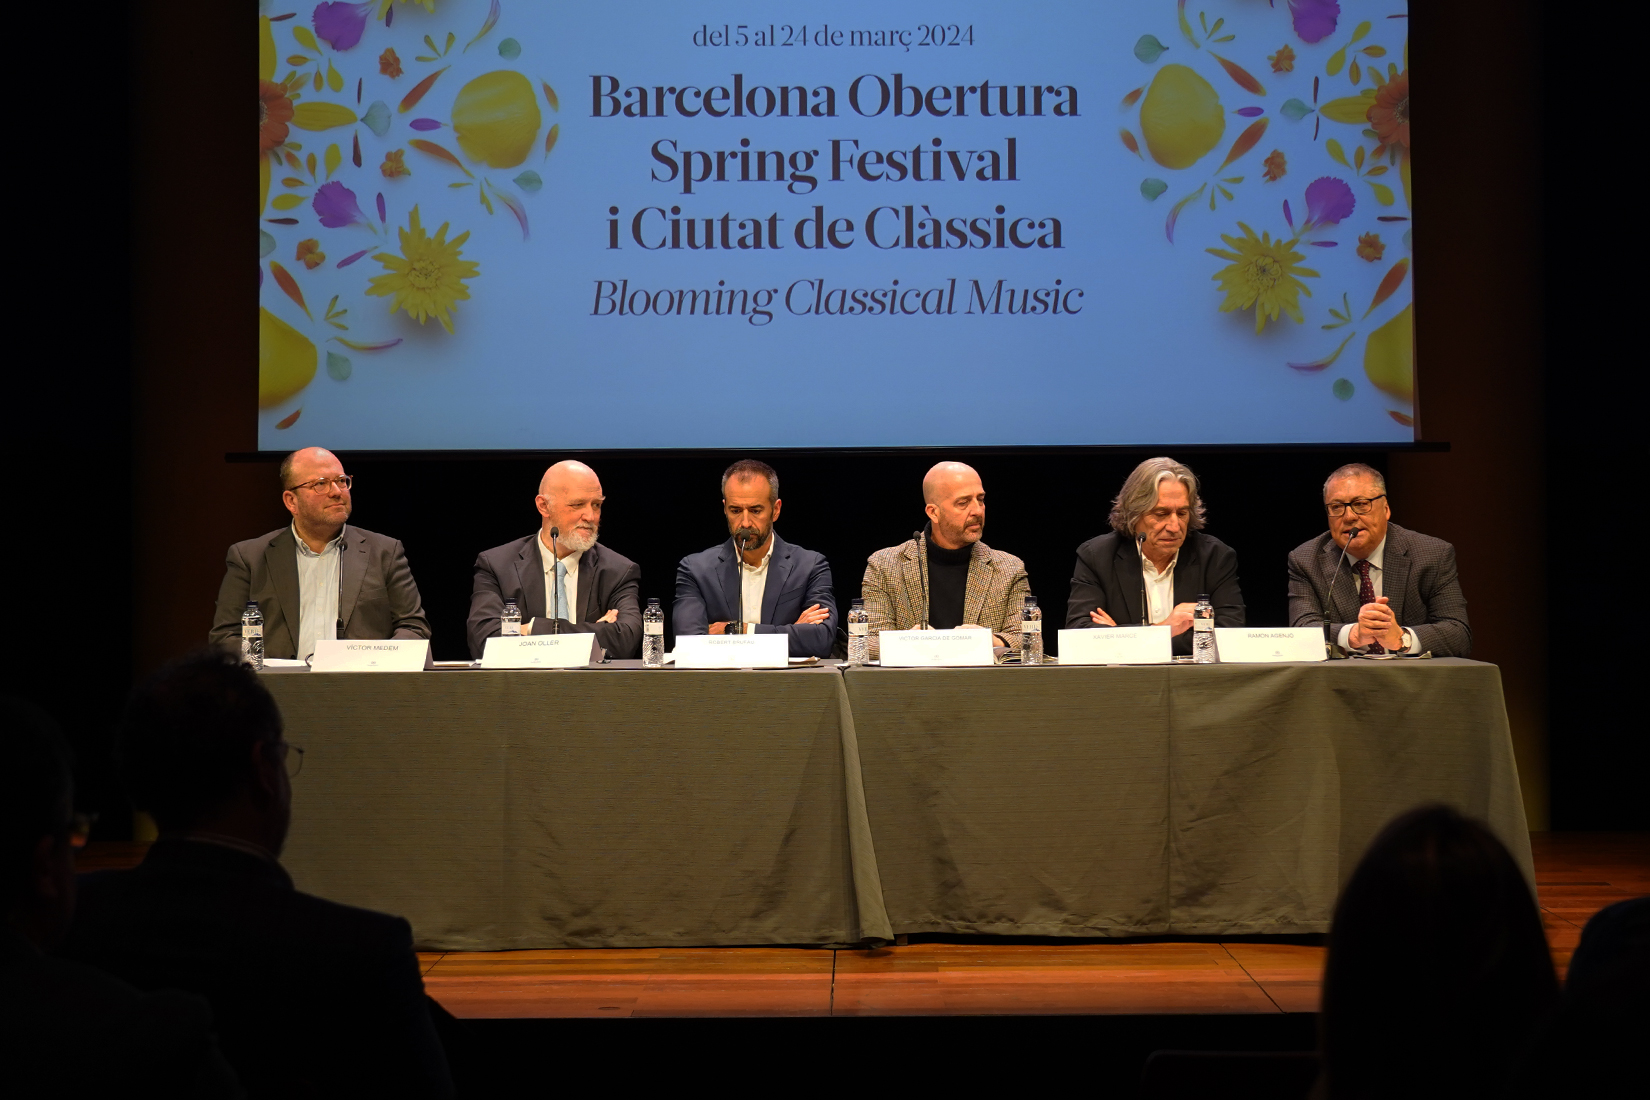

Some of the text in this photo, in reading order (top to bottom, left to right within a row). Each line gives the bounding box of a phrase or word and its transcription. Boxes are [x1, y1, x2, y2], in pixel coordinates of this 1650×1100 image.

[692, 24, 975, 52] del 5 al 24 de març 2024
[588, 72, 1082, 119] Barcelona Obertura
[650, 137, 1021, 195] Spring Festival
[605, 204, 1066, 250] i Ciutat de Clàssica
[589, 278, 1085, 327] Blooming Classical Music
[537, 639, 560, 647] OLLER
